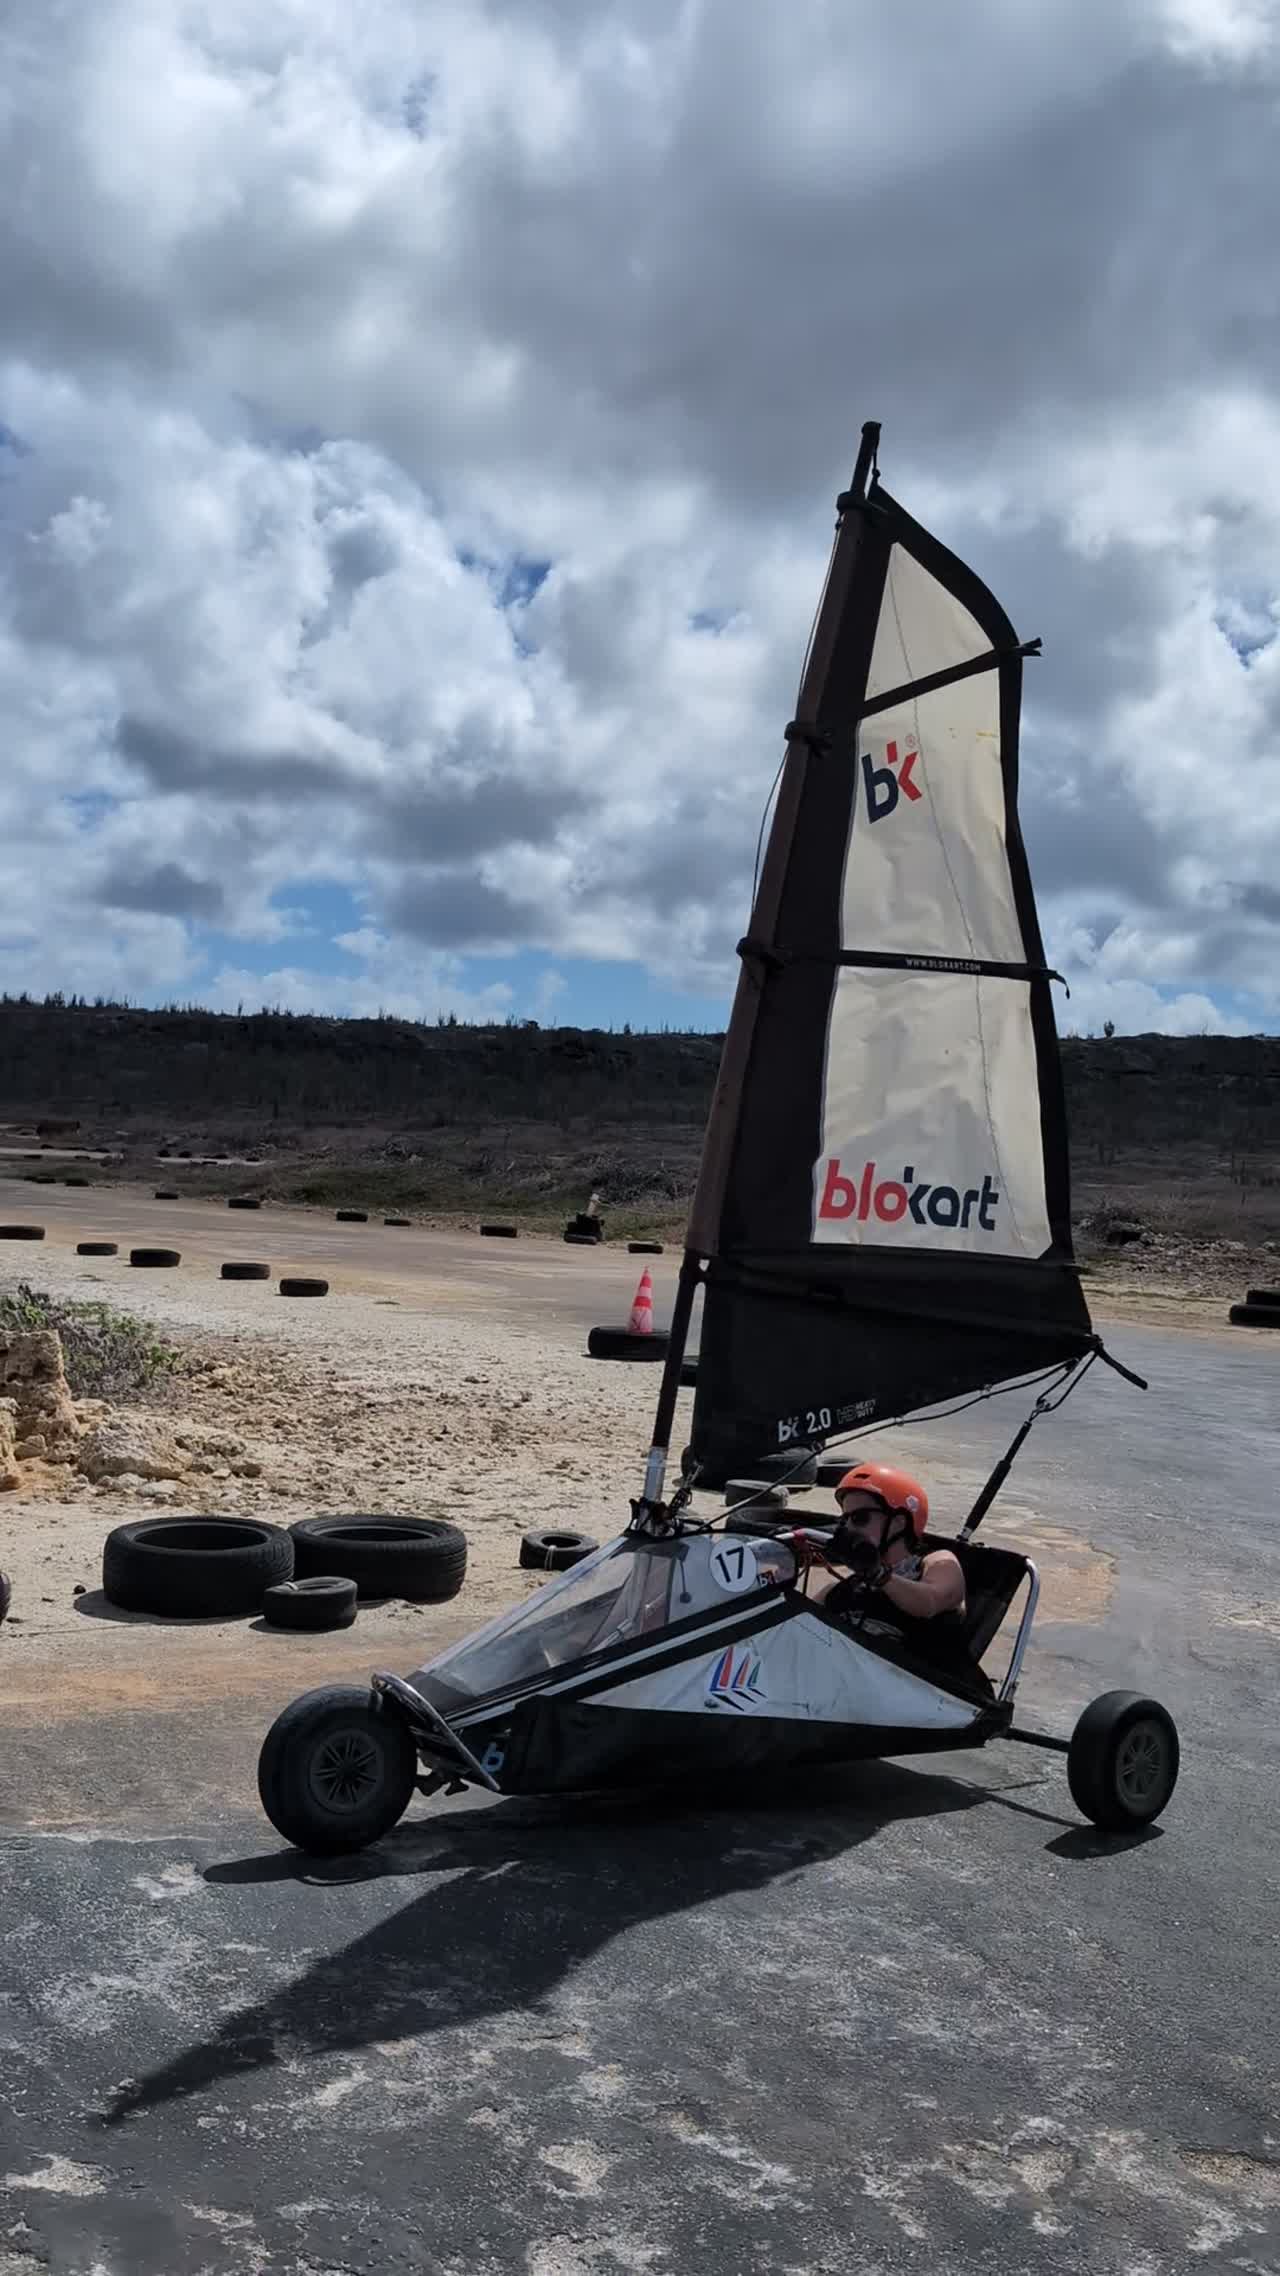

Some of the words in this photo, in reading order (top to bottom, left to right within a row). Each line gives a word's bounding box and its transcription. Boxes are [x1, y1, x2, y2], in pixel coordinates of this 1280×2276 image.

[818, 1159, 999, 1231] blokart
[806, 1407, 832, 1434] 2.0
[714, 1546, 745, 1583] 17
